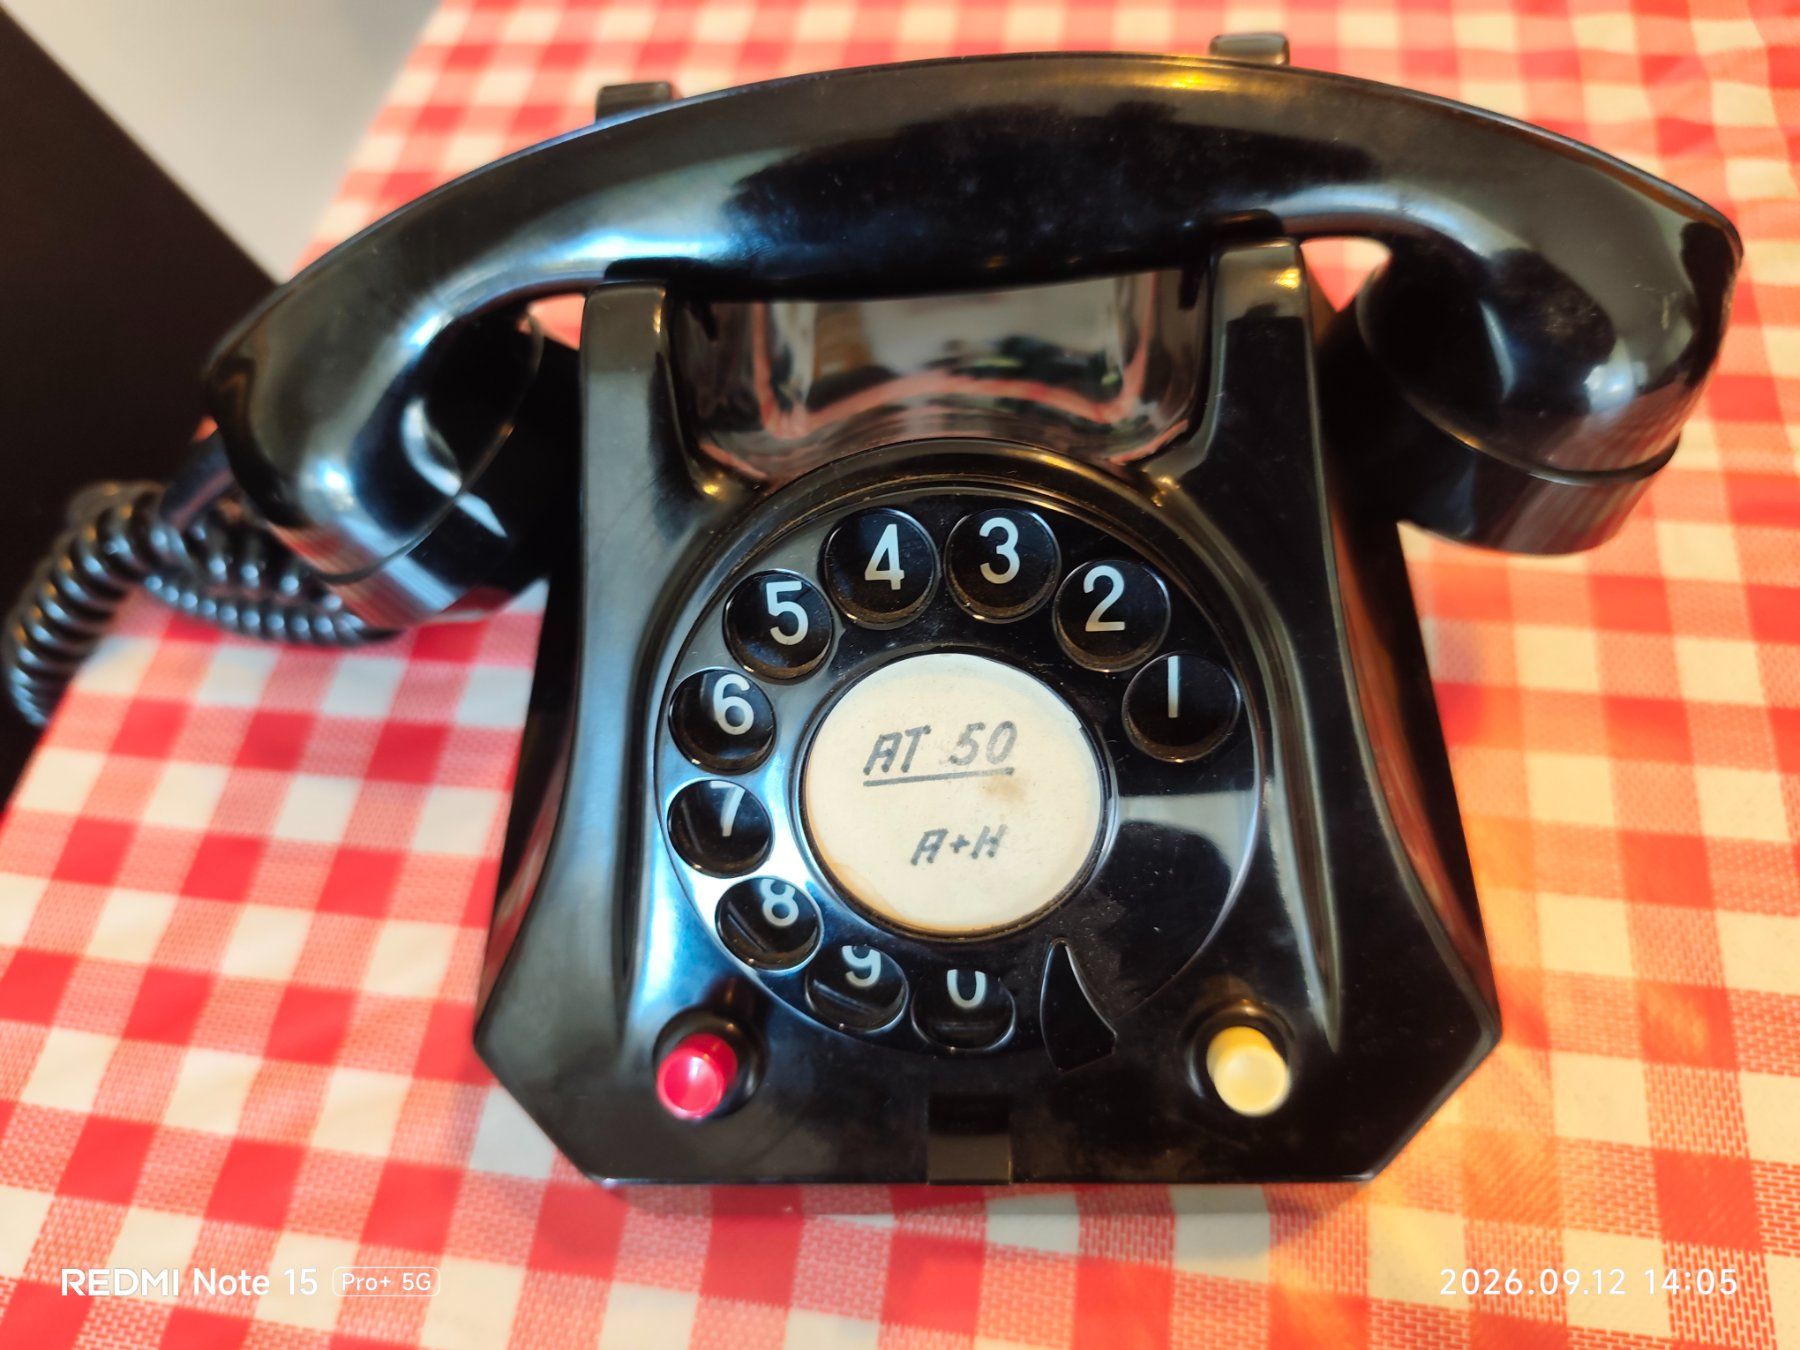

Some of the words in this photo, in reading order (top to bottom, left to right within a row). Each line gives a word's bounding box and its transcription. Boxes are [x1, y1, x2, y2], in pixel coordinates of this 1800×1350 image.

[864, 523, 905, 591] 4
[979, 518, 1020, 584] 3
[765, 581, 809, 645] 5
[1083, 565, 1126, 632] 2
[713, 673, 755, 736] 6
[1167, 655, 1179, 719] 1
[863, 725, 932, 775] AT
[948, 720, 1018, 766] 50
[710, 780, 746, 837] 7
[911, 823, 1008, 866] A+H
[760, 878, 799, 928] 8
[841, 945, 882, 989] 9
